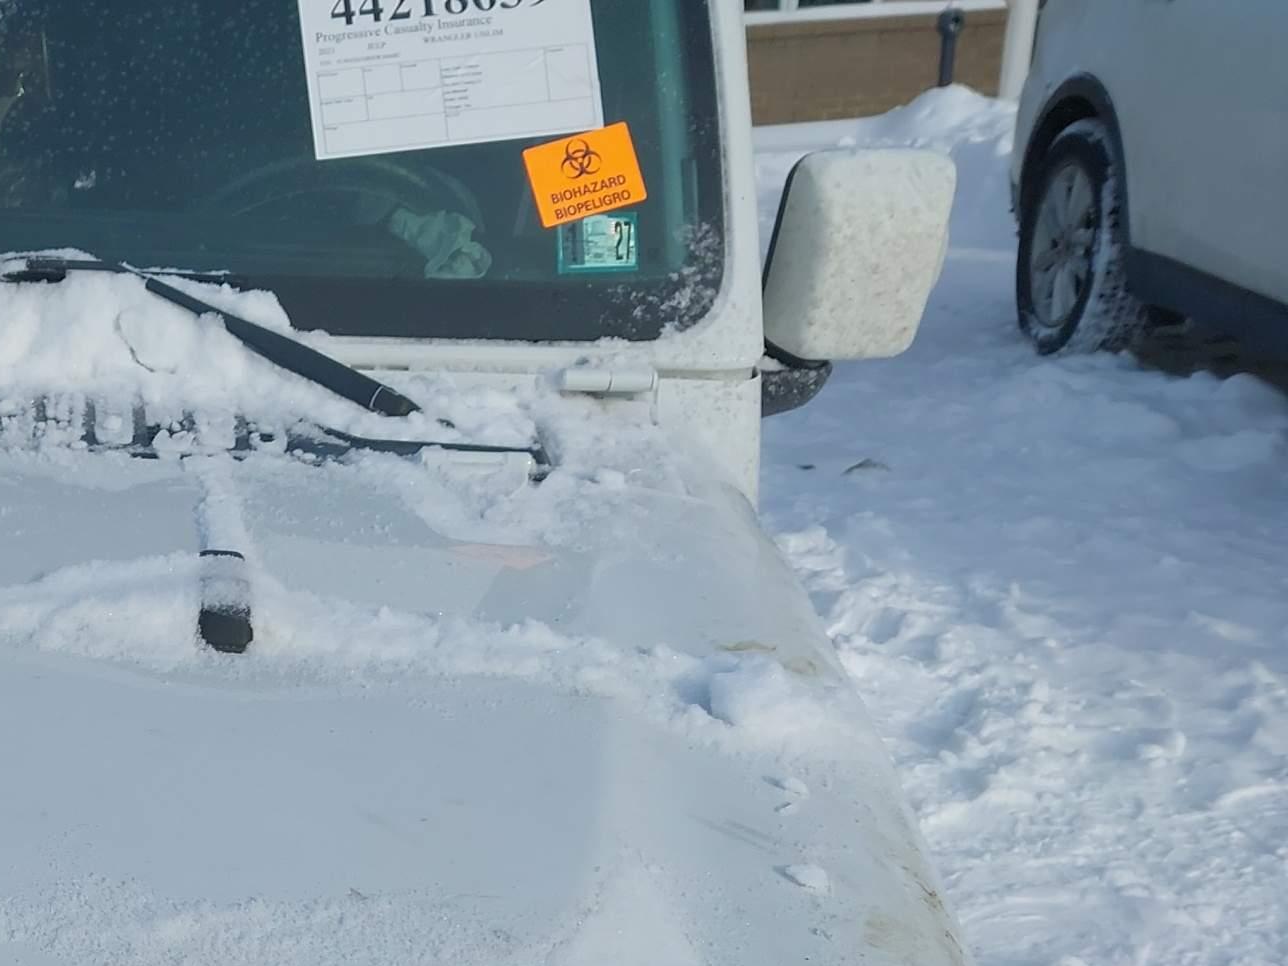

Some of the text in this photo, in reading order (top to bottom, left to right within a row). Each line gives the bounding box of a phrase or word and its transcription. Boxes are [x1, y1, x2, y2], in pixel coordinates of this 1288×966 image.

[315, 17, 493, 43] Progressive Casualty Insurance
[551, 174, 626, 204] BIOHAZARD
[554, 189, 631, 220] BIOPELIGRO
[614, 221, 631, 262] 27
